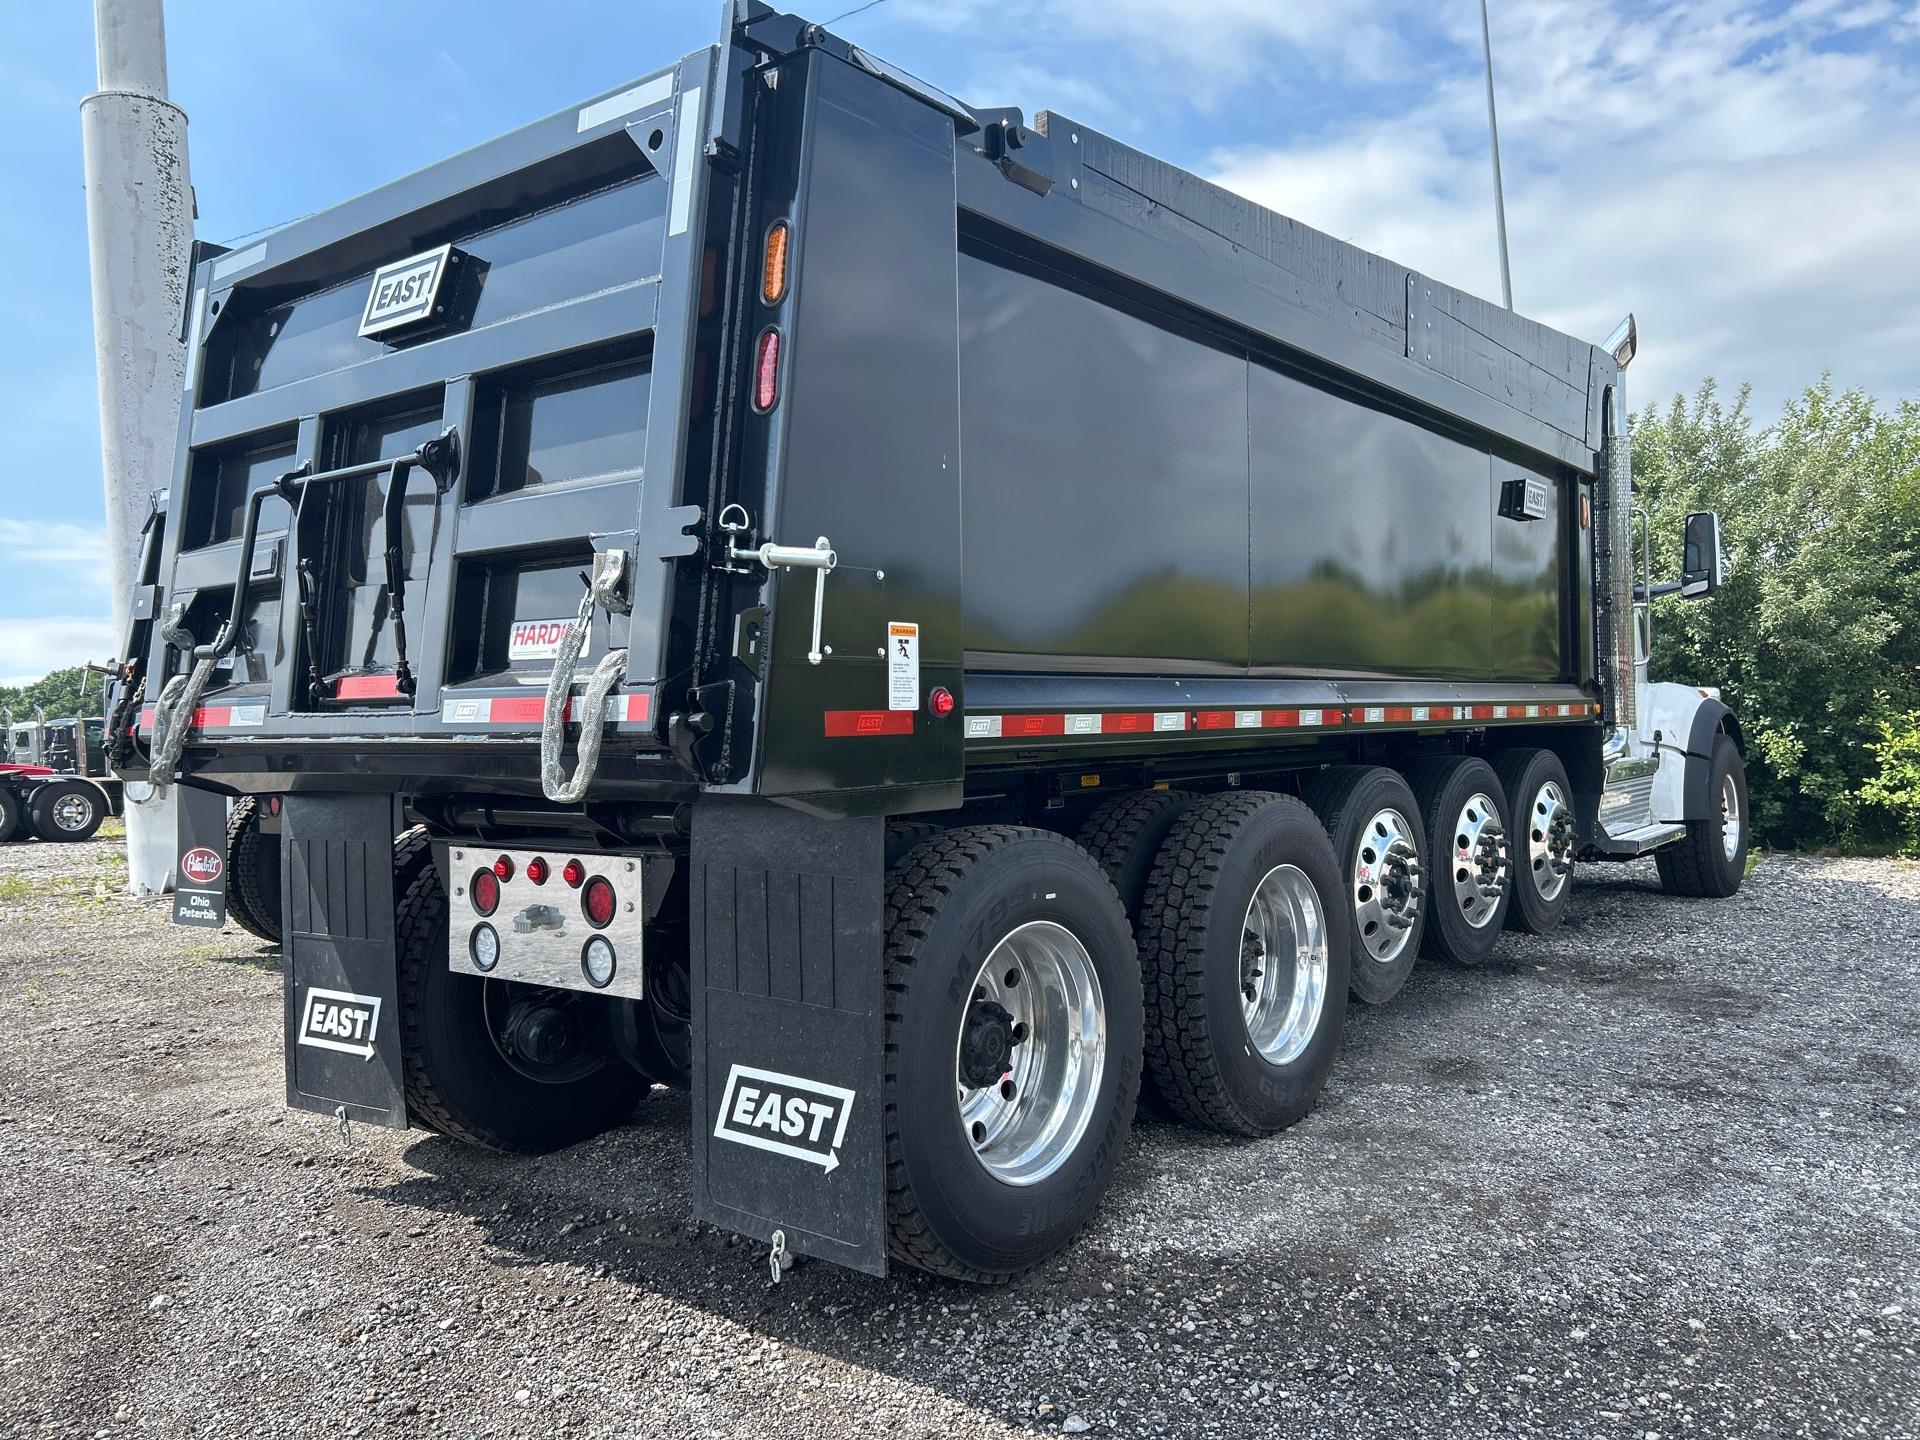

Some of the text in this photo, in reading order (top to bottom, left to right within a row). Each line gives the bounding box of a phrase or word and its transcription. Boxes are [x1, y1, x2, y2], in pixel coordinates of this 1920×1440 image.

[376, 270, 431, 311] EAST
[1528, 489, 1544, 508] EAST
[860, 717, 881, 728] EAST
[971, 722, 989, 732] EAST
[190, 896, 210, 907] Ohio
[179, 907, 218, 920] Peterbilt
[309, 1003, 369, 1039] EAST
[732, 1086, 834, 1142] EAST
